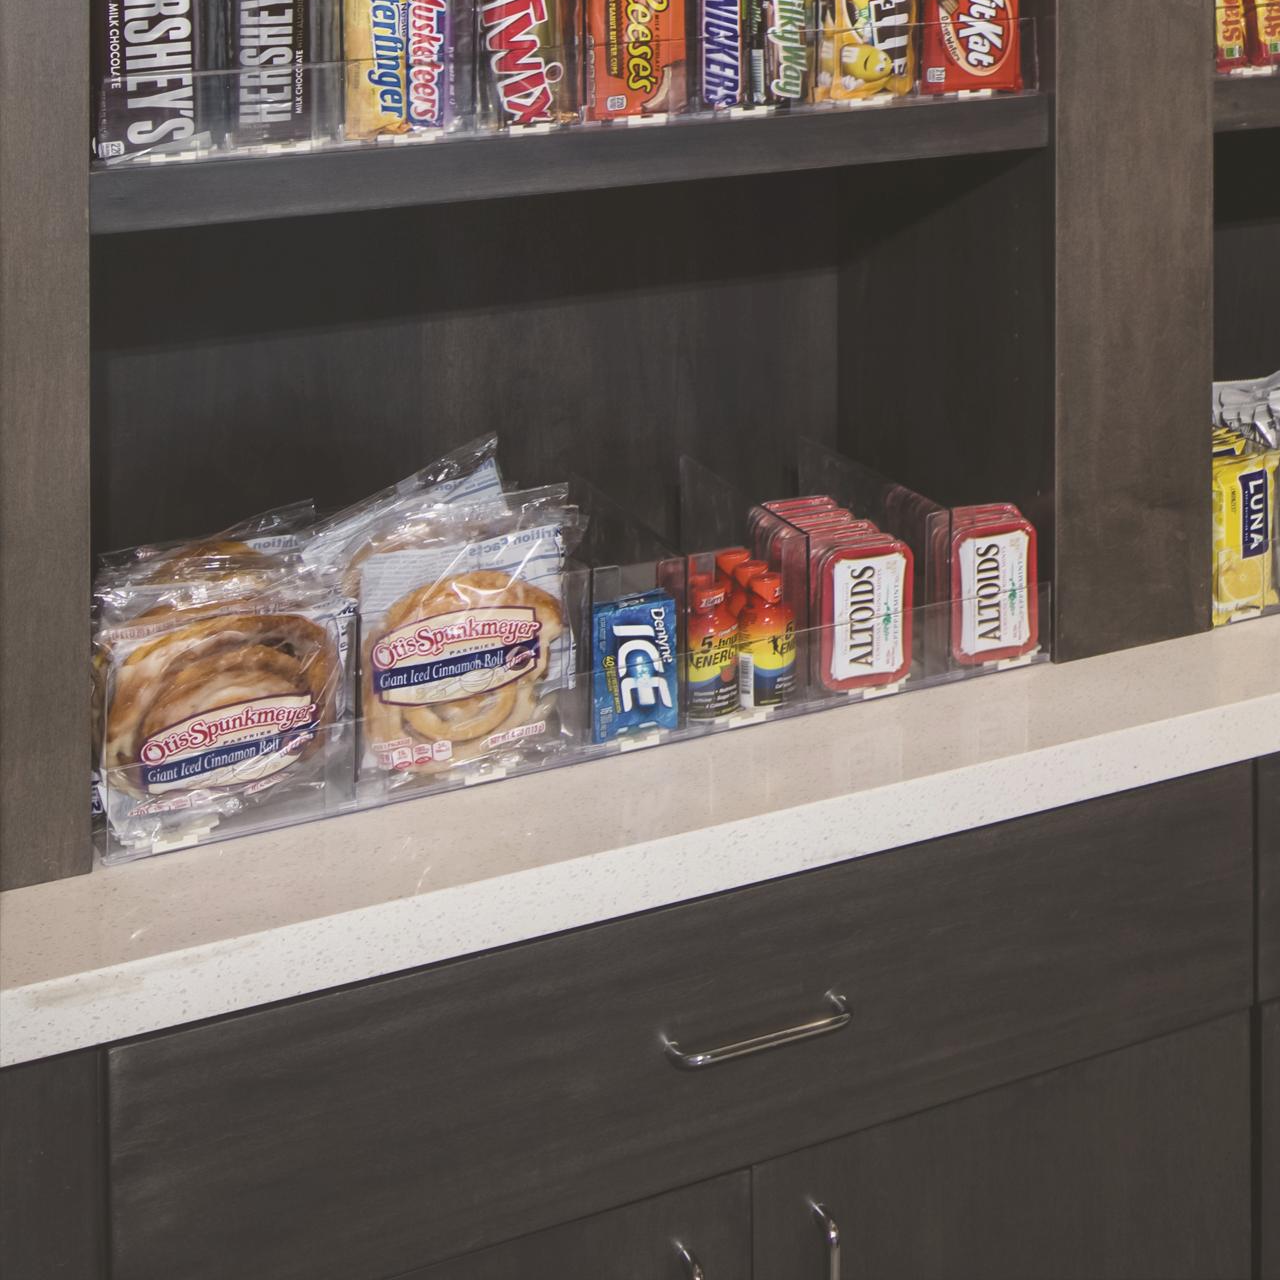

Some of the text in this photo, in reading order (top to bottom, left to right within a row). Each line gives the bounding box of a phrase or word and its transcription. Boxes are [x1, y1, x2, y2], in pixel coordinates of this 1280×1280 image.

[108, 3, 122, 89] MILK CHOCOLATE
[771, 36, 807, 98] Way
[295, 92, 303, 114] MILK
[1248, 479, 1264, 550] LUNA
[849, 565, 875, 668] ALTOIDS
[976, 543, 1001, 642] ALTOIDS
[416, 617, 542, 655] Spunkmeyer
[650, 607, 673, 663] Dentyne
[379, 650, 505, 690] Giant Iced Cinnamon Roll
[612, 624, 673, 712] ICE
[189, 701, 318, 749] Spunkmeyer
[147, 764, 179, 784] Giant
[180, 760, 202, 779] Iced
[203, 742, 257, 773] Cinnamon
